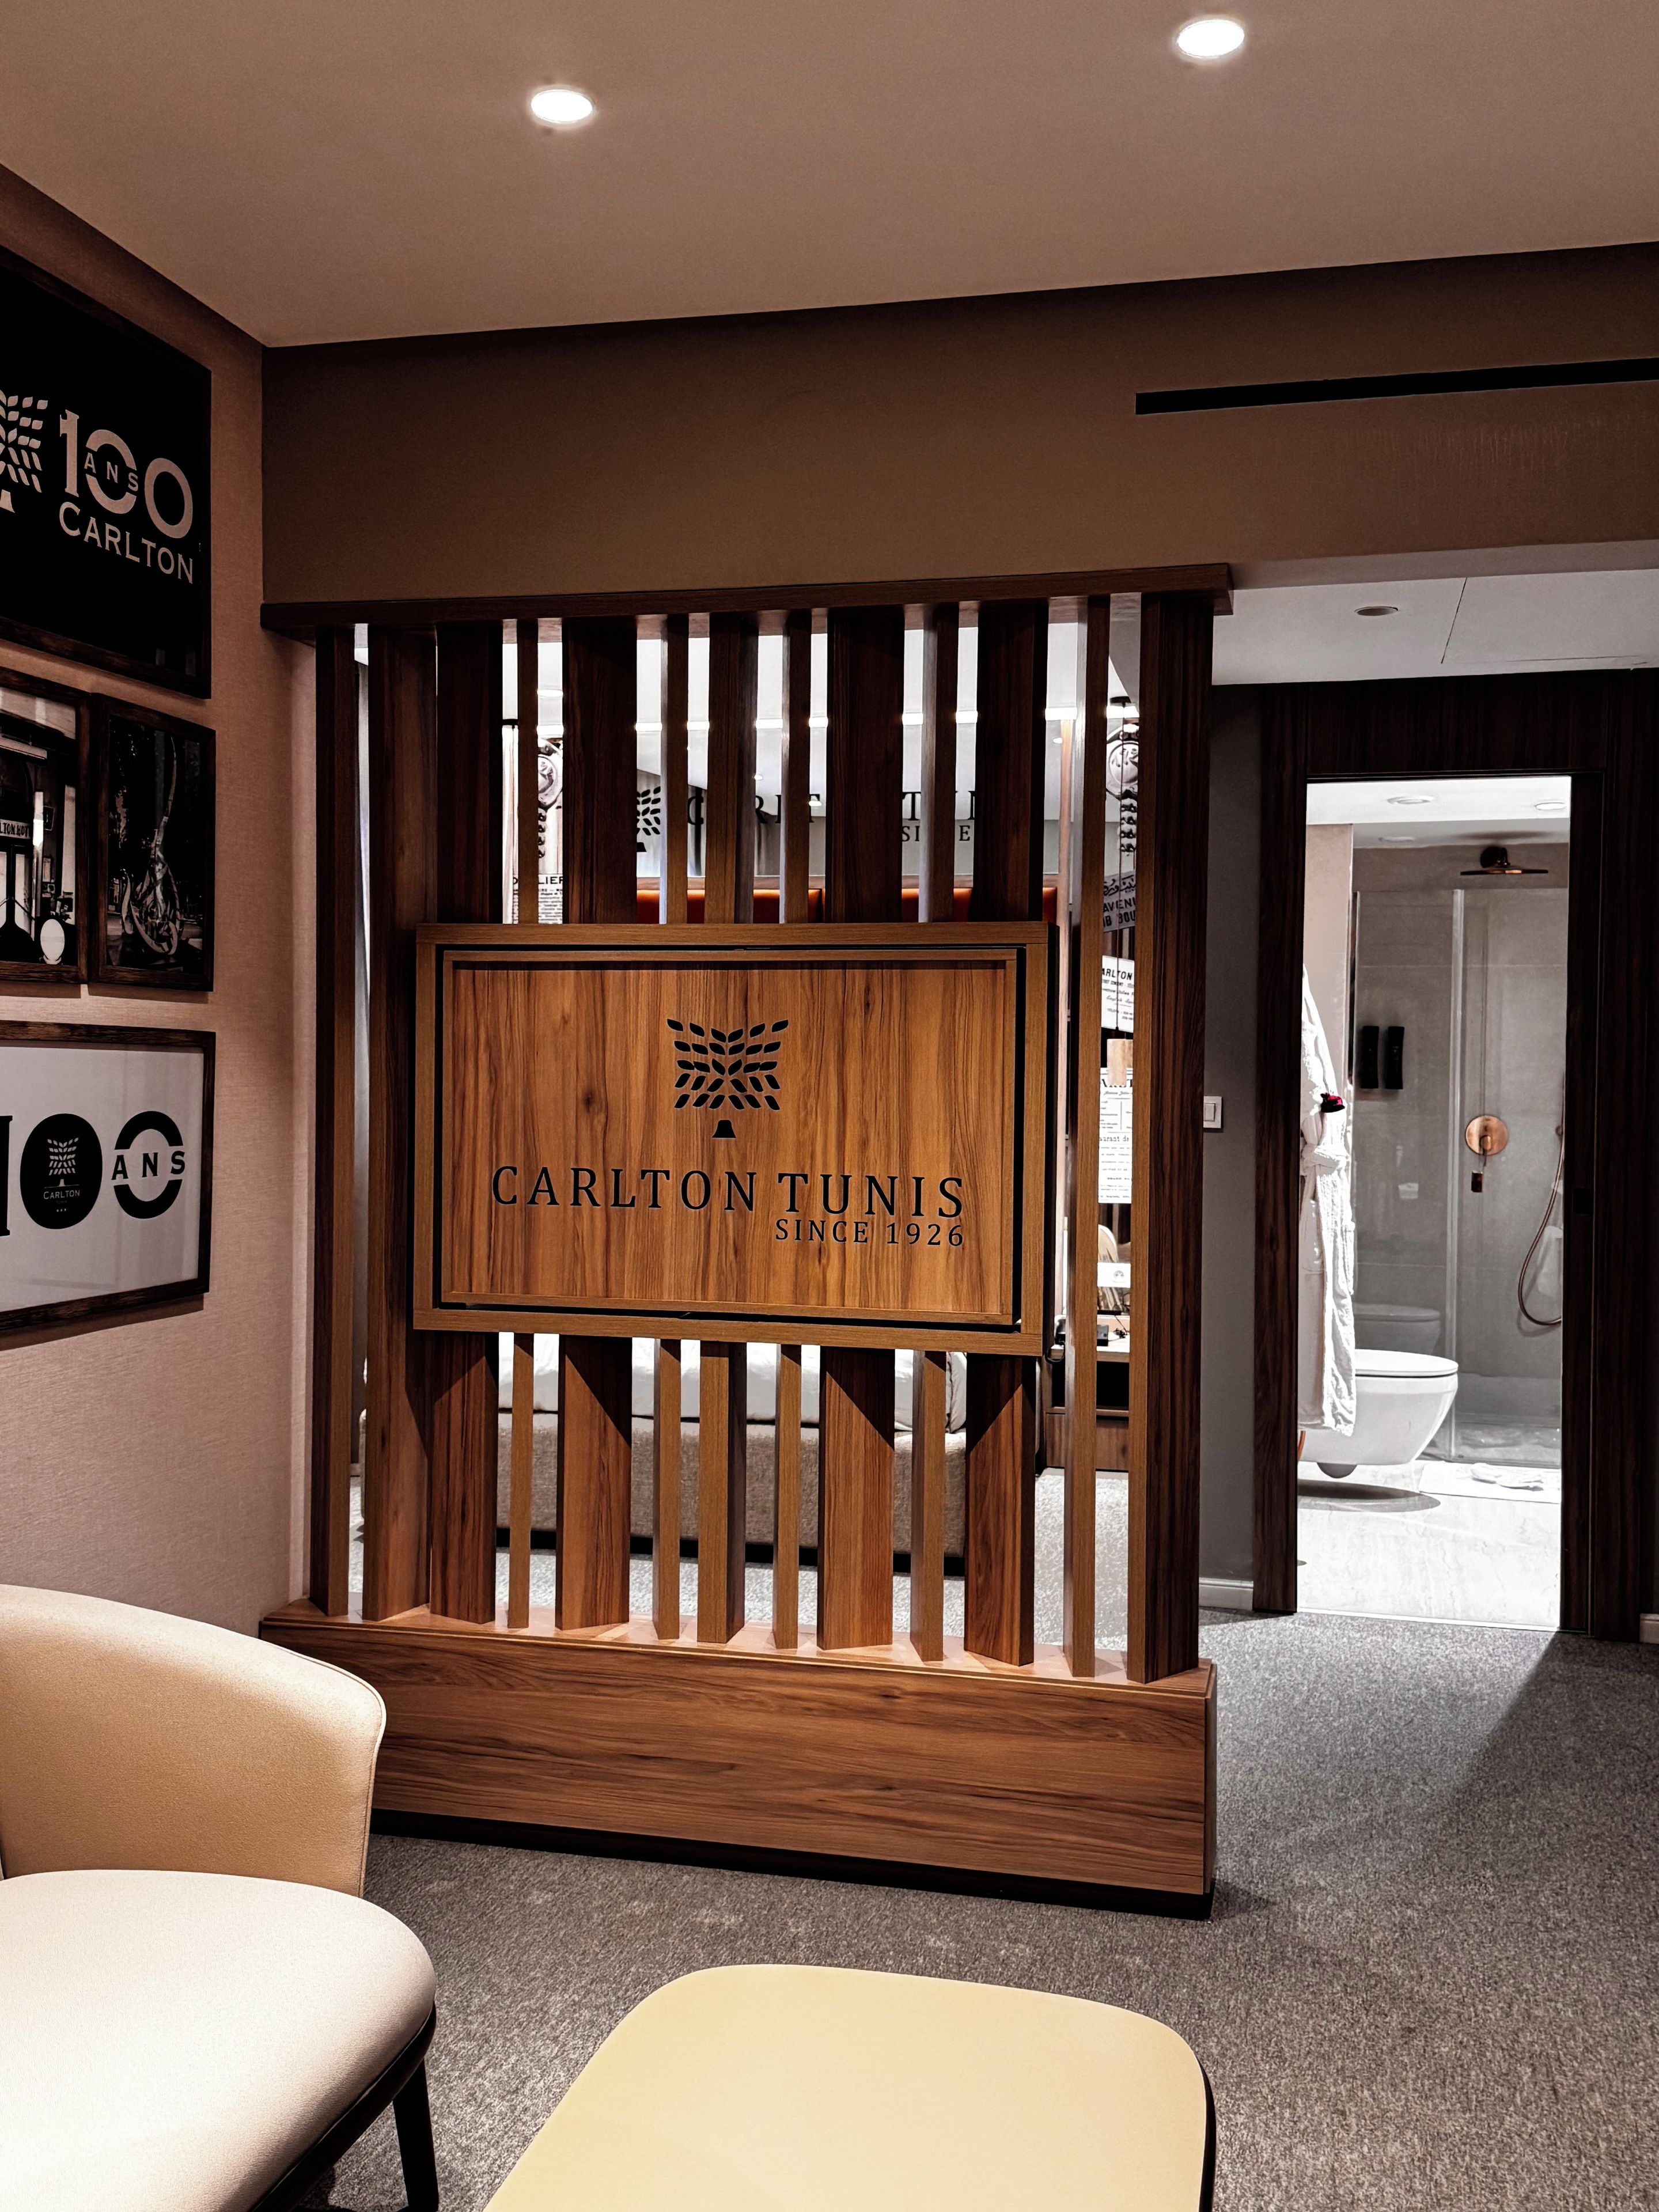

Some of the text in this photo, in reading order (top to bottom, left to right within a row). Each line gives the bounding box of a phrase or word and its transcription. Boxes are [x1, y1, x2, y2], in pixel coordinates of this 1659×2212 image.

[59, 409, 194, 539] 100
[84, 452, 139, 491] ANS
[59, 501, 194, 584] CARLTON
[111, 1150, 185, 1180] ANS
[43, 1190, 80, 1200] CARLTON
[491, 1165, 963, 1218] CARLTON TUNIS
[775, 1218, 963, 1247] SINCE 1926
